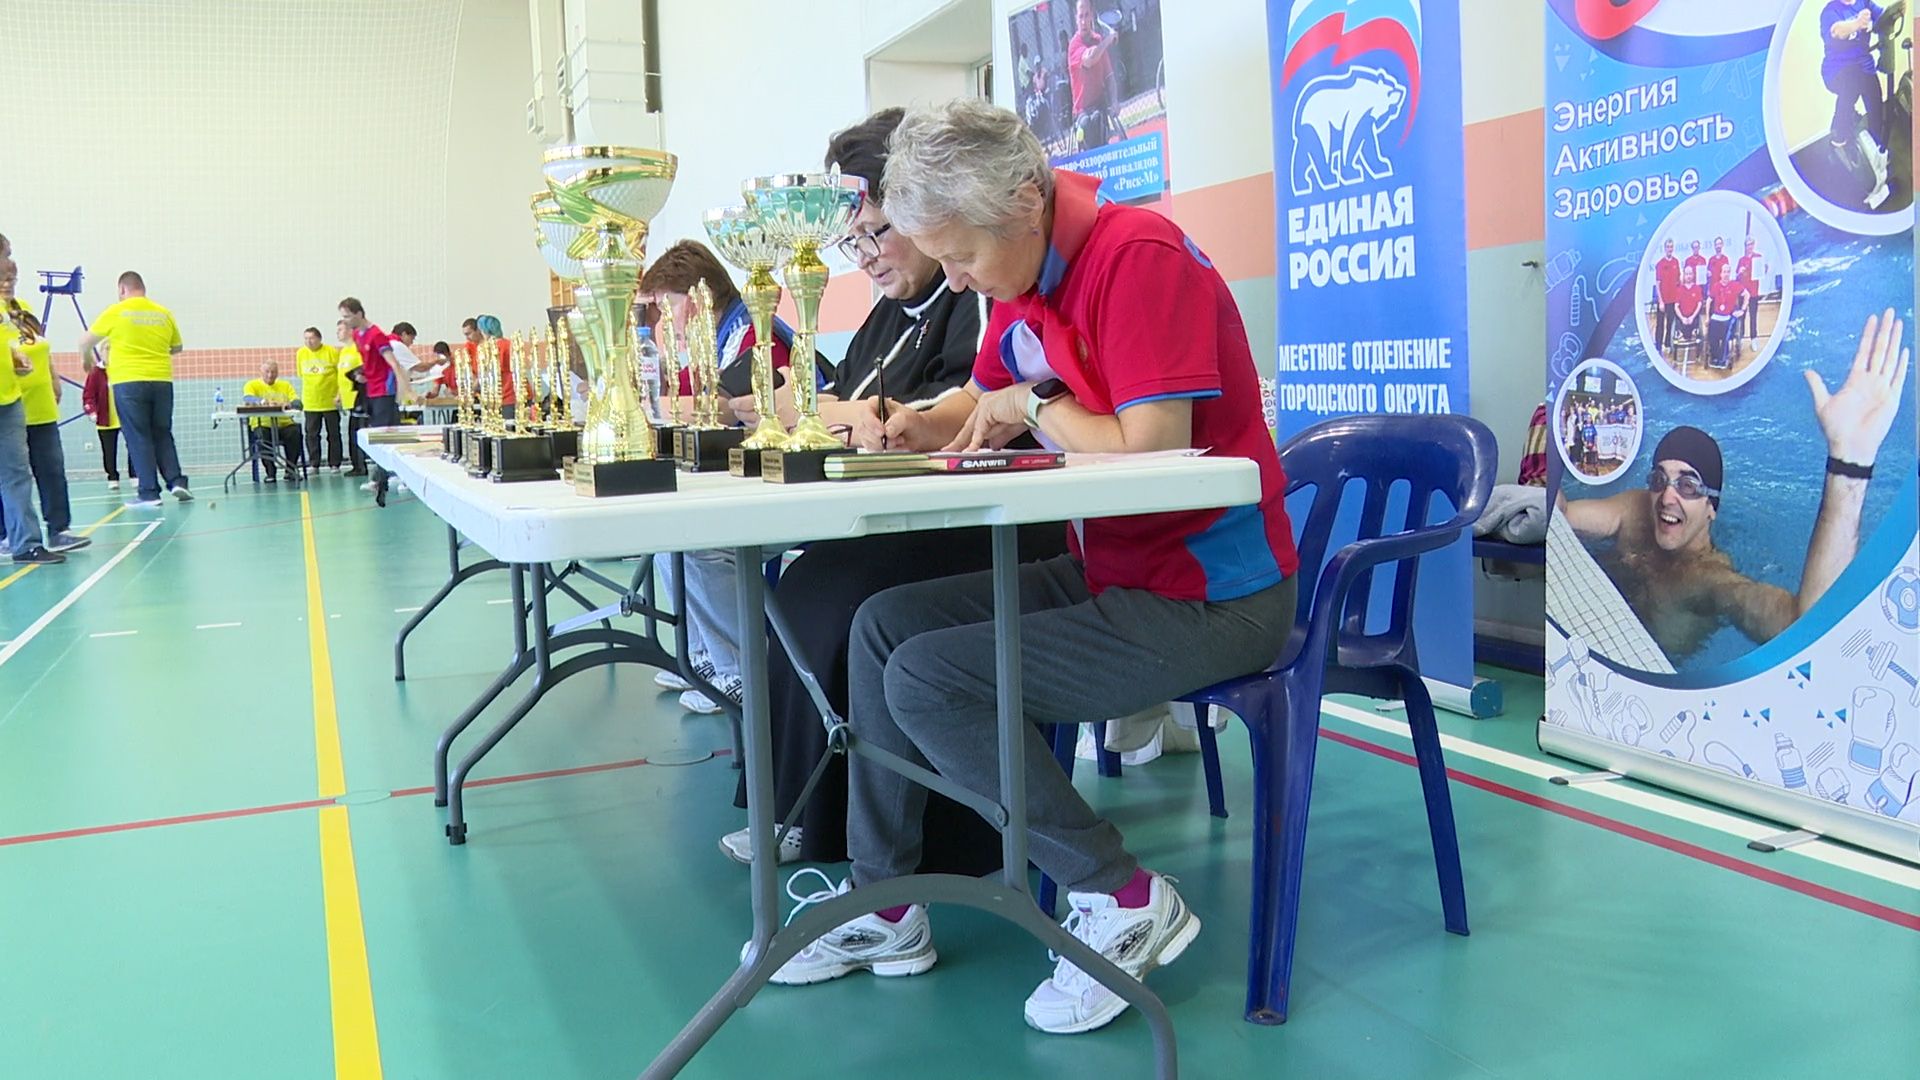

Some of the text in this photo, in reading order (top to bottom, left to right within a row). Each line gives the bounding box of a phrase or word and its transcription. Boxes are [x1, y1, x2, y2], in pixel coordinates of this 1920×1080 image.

[1553, 77, 1677, 132] Энергия
[1110, 156, 1159, 179] инвалидов
[1553, 114, 1734, 176] Активность
[1288, 185, 1414, 246] ЕДИНАЯ
[1553, 168, 1699, 220] Здоровье
[1289, 235, 1416, 290] РОССИЯ
[1279, 338, 1452, 374] МЕСТНОЕ ОТДЕЛЕНИЕ
[1280, 383, 1451, 415] ГОРОДСКОГО ОКРУГА
[962, 458, 1007, 469] SANWEI
